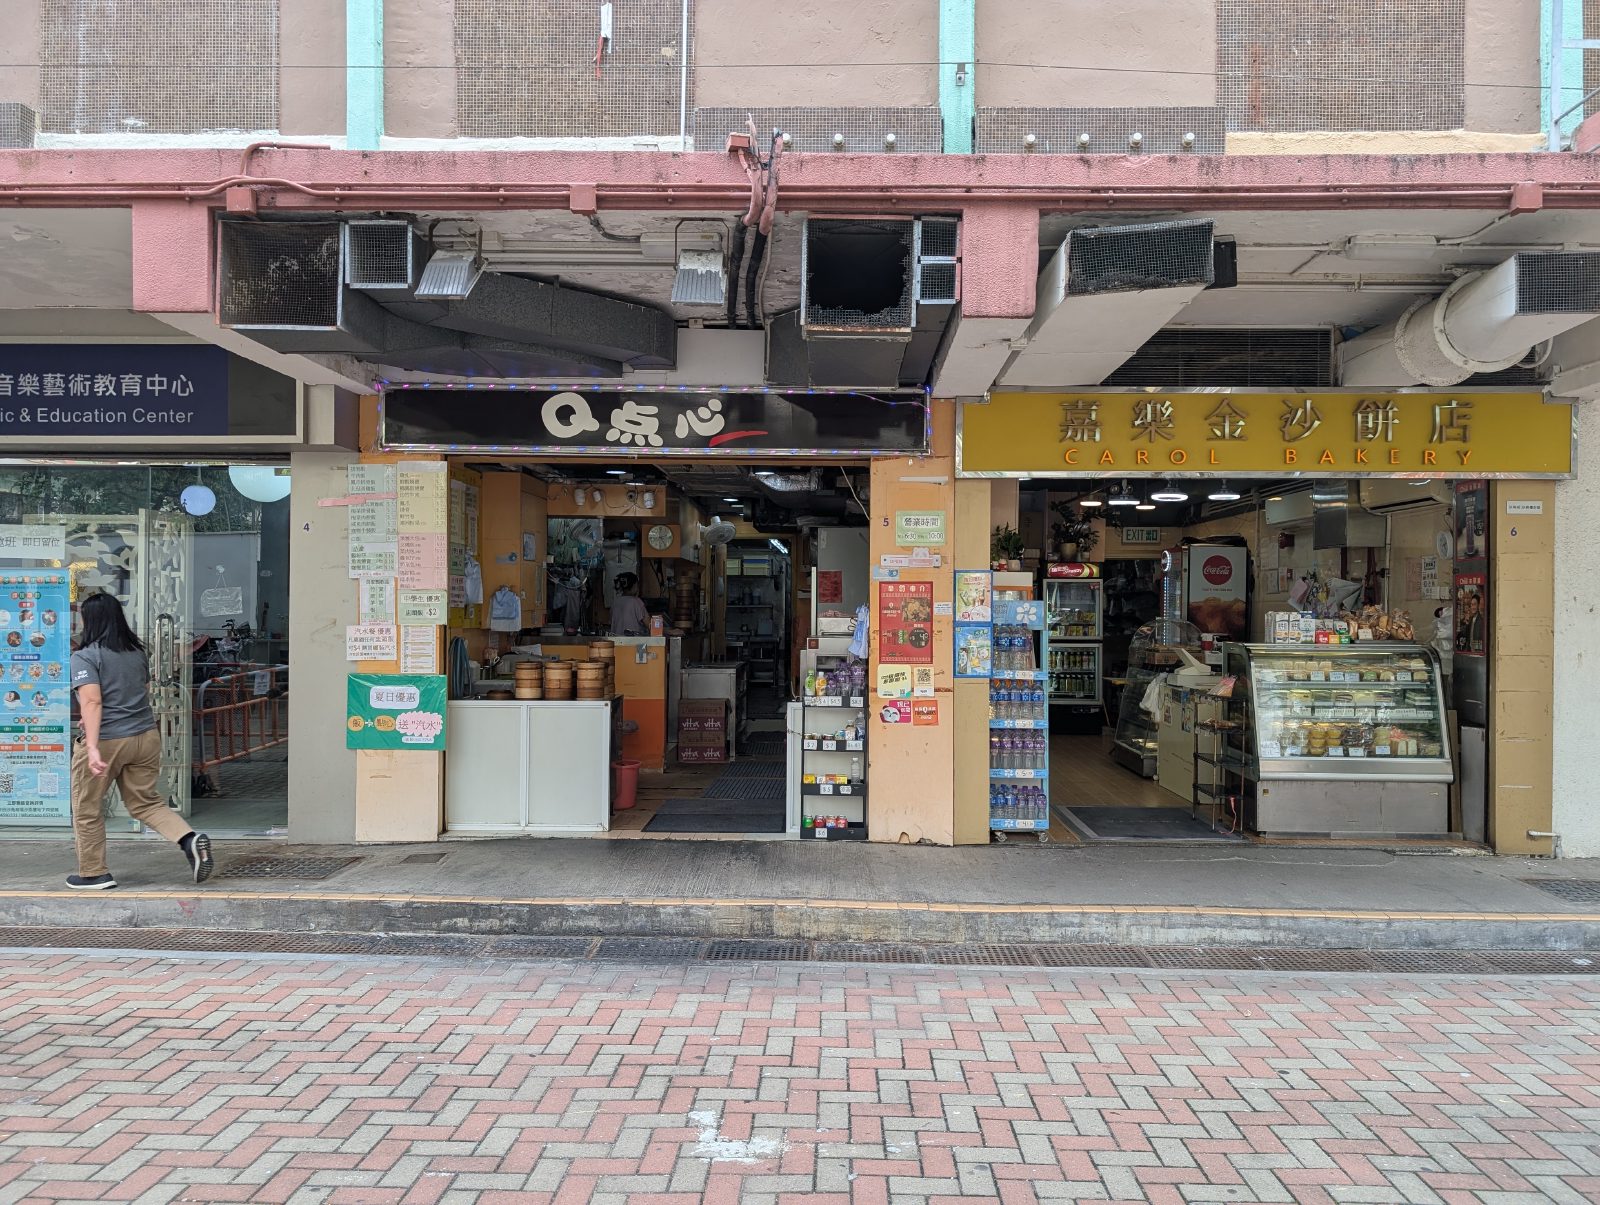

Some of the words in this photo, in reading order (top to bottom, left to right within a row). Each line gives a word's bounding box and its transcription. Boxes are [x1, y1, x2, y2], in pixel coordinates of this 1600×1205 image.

[0, 373, 195, 398] 音樂藝術教育中心
[20, 408, 31, 423] &
[37, 407, 127, 424] Education
[132, 407, 194, 424] Center
[1059, 398, 1475, 444] 嘉樂金沙餅店
[1064, 448, 1220, 466] CAROL
[1285, 448, 1474, 466] BAKERY
[303, 522, 310, 533] 4
[882, 518, 890, 527] 5
[904, 518, 938, 527] 營業時間
[1126, 529, 1144, 540] EXIT
[1510, 527, 1518, 537] 6
[374, 692, 416, 702] 夏日優惠
